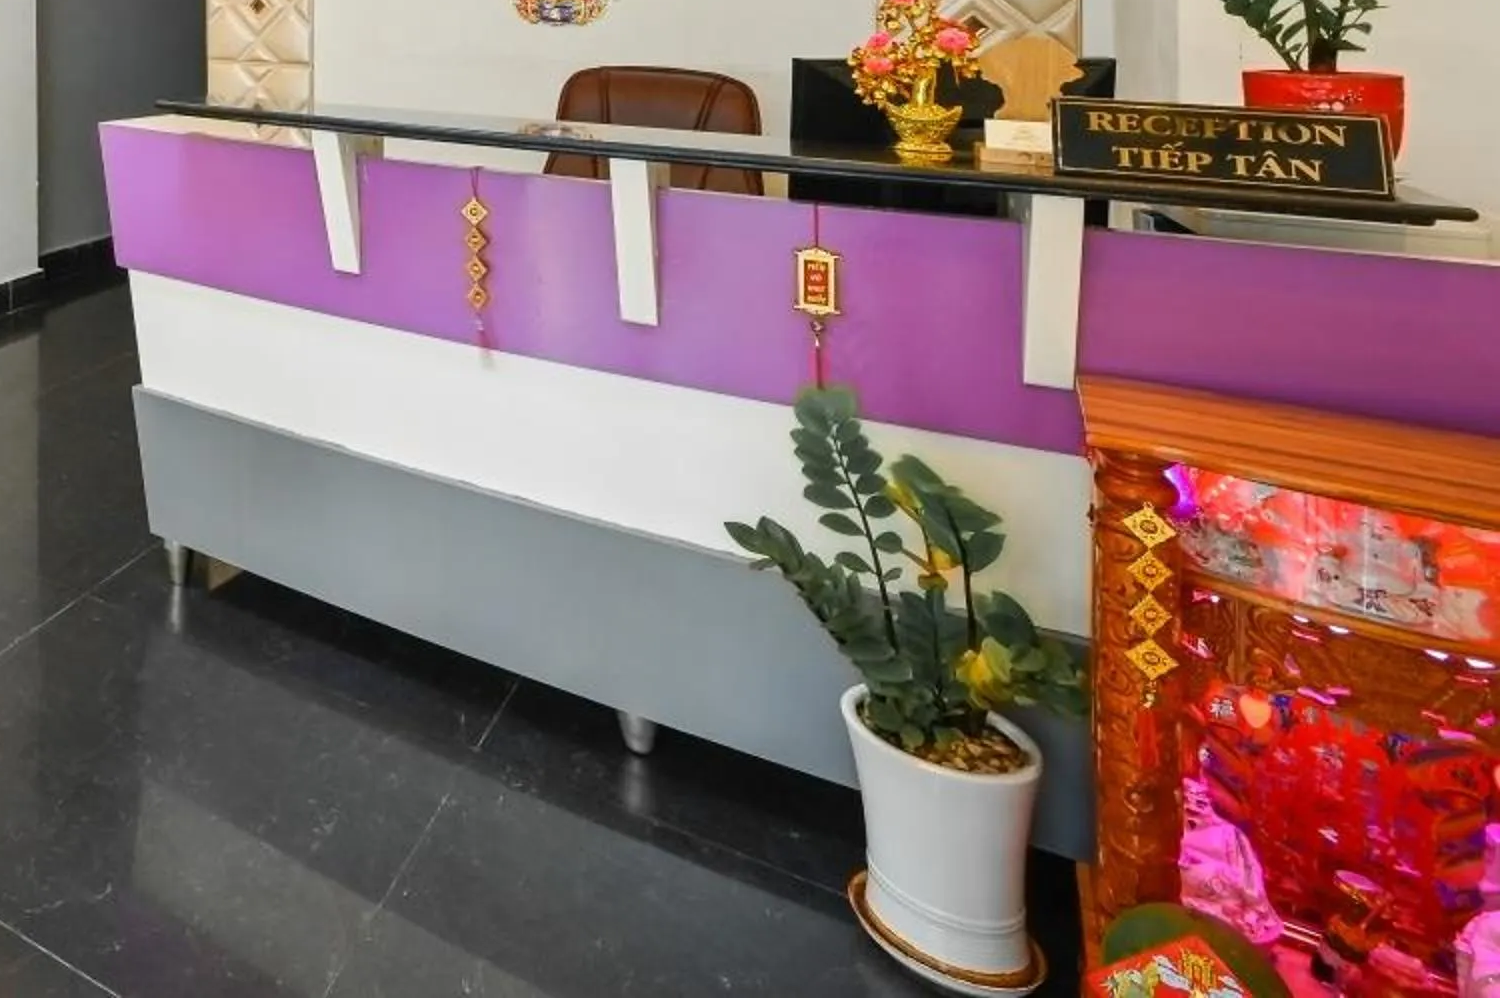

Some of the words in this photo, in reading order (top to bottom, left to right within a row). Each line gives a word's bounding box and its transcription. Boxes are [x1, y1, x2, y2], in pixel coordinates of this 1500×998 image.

[1085, 110, 1348, 148] RECEPTION
[1112, 141, 1213, 174] TIẾP
[1226, 149, 1324, 183] TÂN
